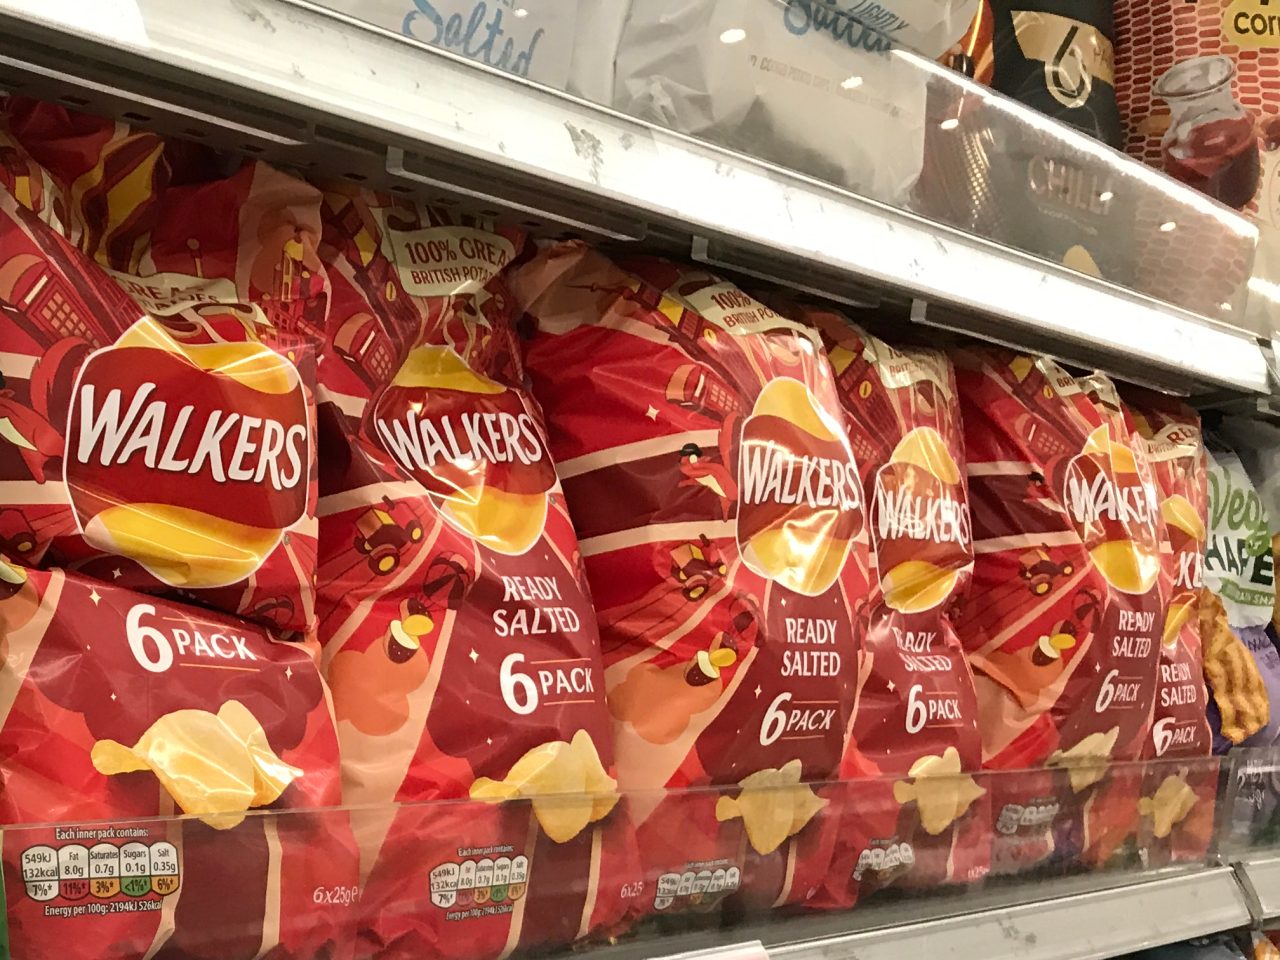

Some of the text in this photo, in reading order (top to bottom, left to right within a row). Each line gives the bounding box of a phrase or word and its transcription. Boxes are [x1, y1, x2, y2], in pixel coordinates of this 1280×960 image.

[404, 236, 510, 267] 100% GREA
[411, 267, 460, 285] BRITISH
[75, 382, 306, 490] WALKERS
[378, 409, 542, 471] WALKERS
[743, 441, 861, 512] WALKERS
[877, 482, 970, 546] WALKERS
[502, 576, 561, 602] READY
[493, 608, 580, 637] SALTED
[785, 618, 837, 645] READY
[1118, 609, 1156, 633] READY
[125, 604, 257, 673] 6 PACK
[1112, 636, 1152, 659] SALTED
[780, 650, 841, 677] SALTED
[1161, 664, 1193, 683] READY
[499, 652, 595, 715] 6 PACK
[1095, 669, 1141, 713] 6 PACK
[1161, 685, 1197, 707] SALTED
[759, 692, 836, 746] 6 PACK
[905, 684, 962, 734] 6 PACK
[1152, 717, 1196, 757] 6 PACK
[56, 828, 75, 840] Each
[76, 829, 96, 839] inner
[97, 829, 116, 841] pack
[25, 853, 51, 864] 549kJ
[69, 851, 79, 861] Fat
[123, 849, 146, 860] Sugars
[157, 848, 170, 857] Salt
[23, 867, 58, 879] 132kcal
[64, 866, 84, 877] 8.0g
[95, 864, 114, 875] 0.7g
[125, 862, 146, 873] 0.1g
[153, 862, 176, 872] 0.35g
[45, 905, 71, 917] Energy
[73, 906, 86, 916] per
